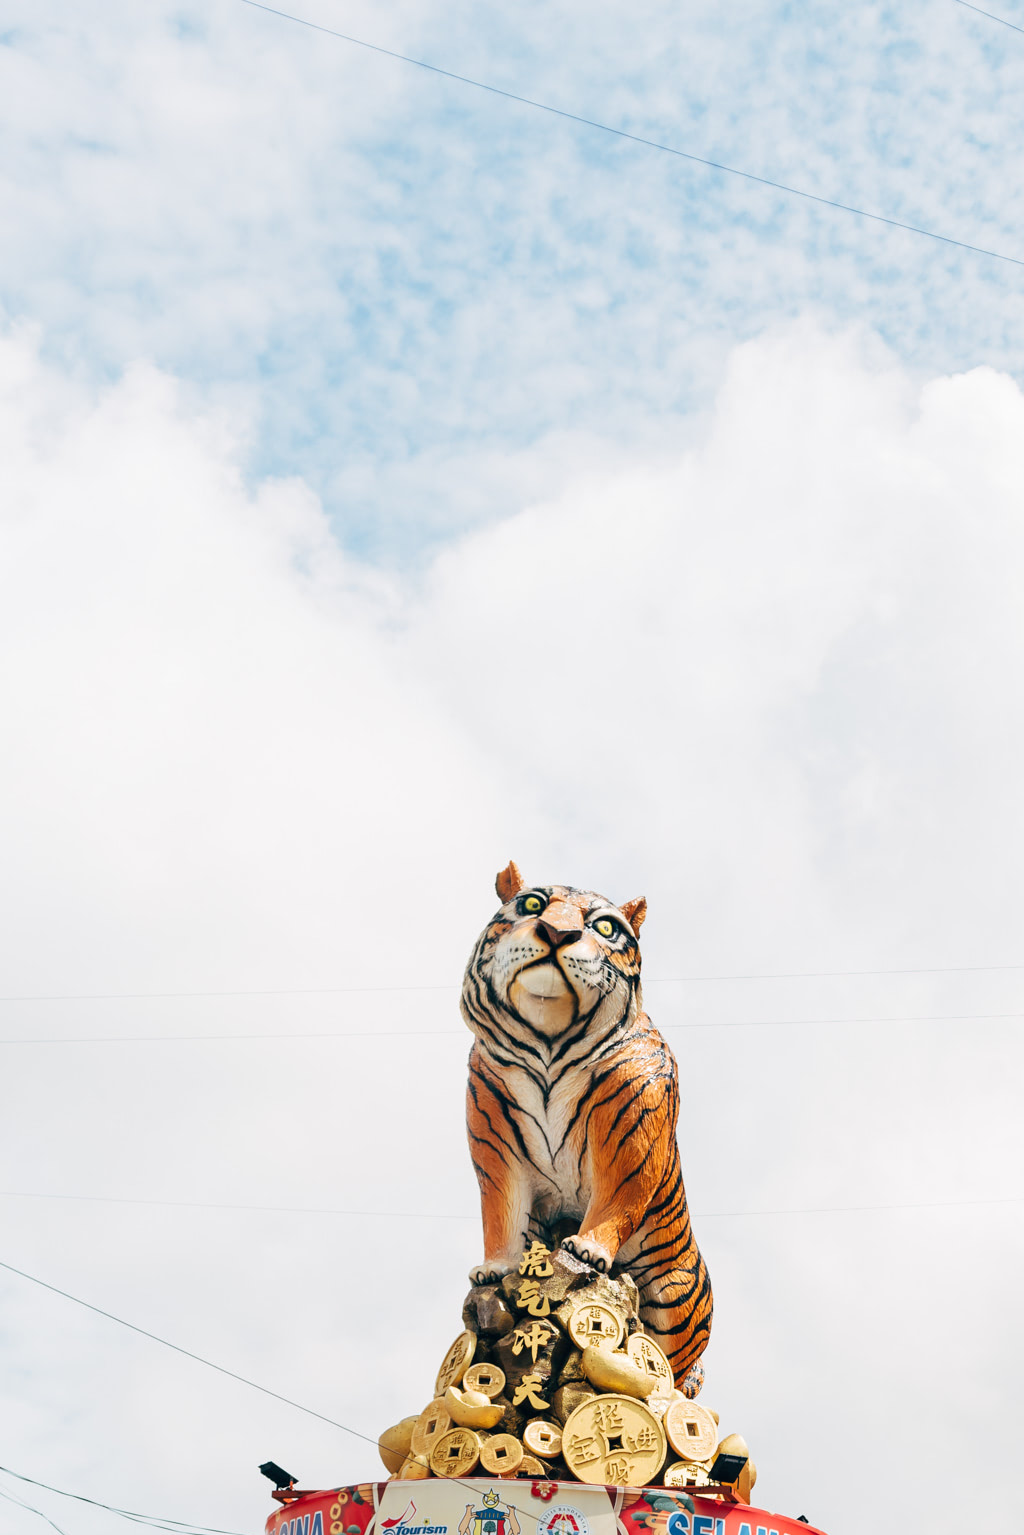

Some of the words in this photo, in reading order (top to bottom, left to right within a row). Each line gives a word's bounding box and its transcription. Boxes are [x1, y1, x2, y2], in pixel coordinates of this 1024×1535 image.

[511, 1240, 555, 1411] 虎气冲天
[396, 1524, 447, 1535] Tourism
